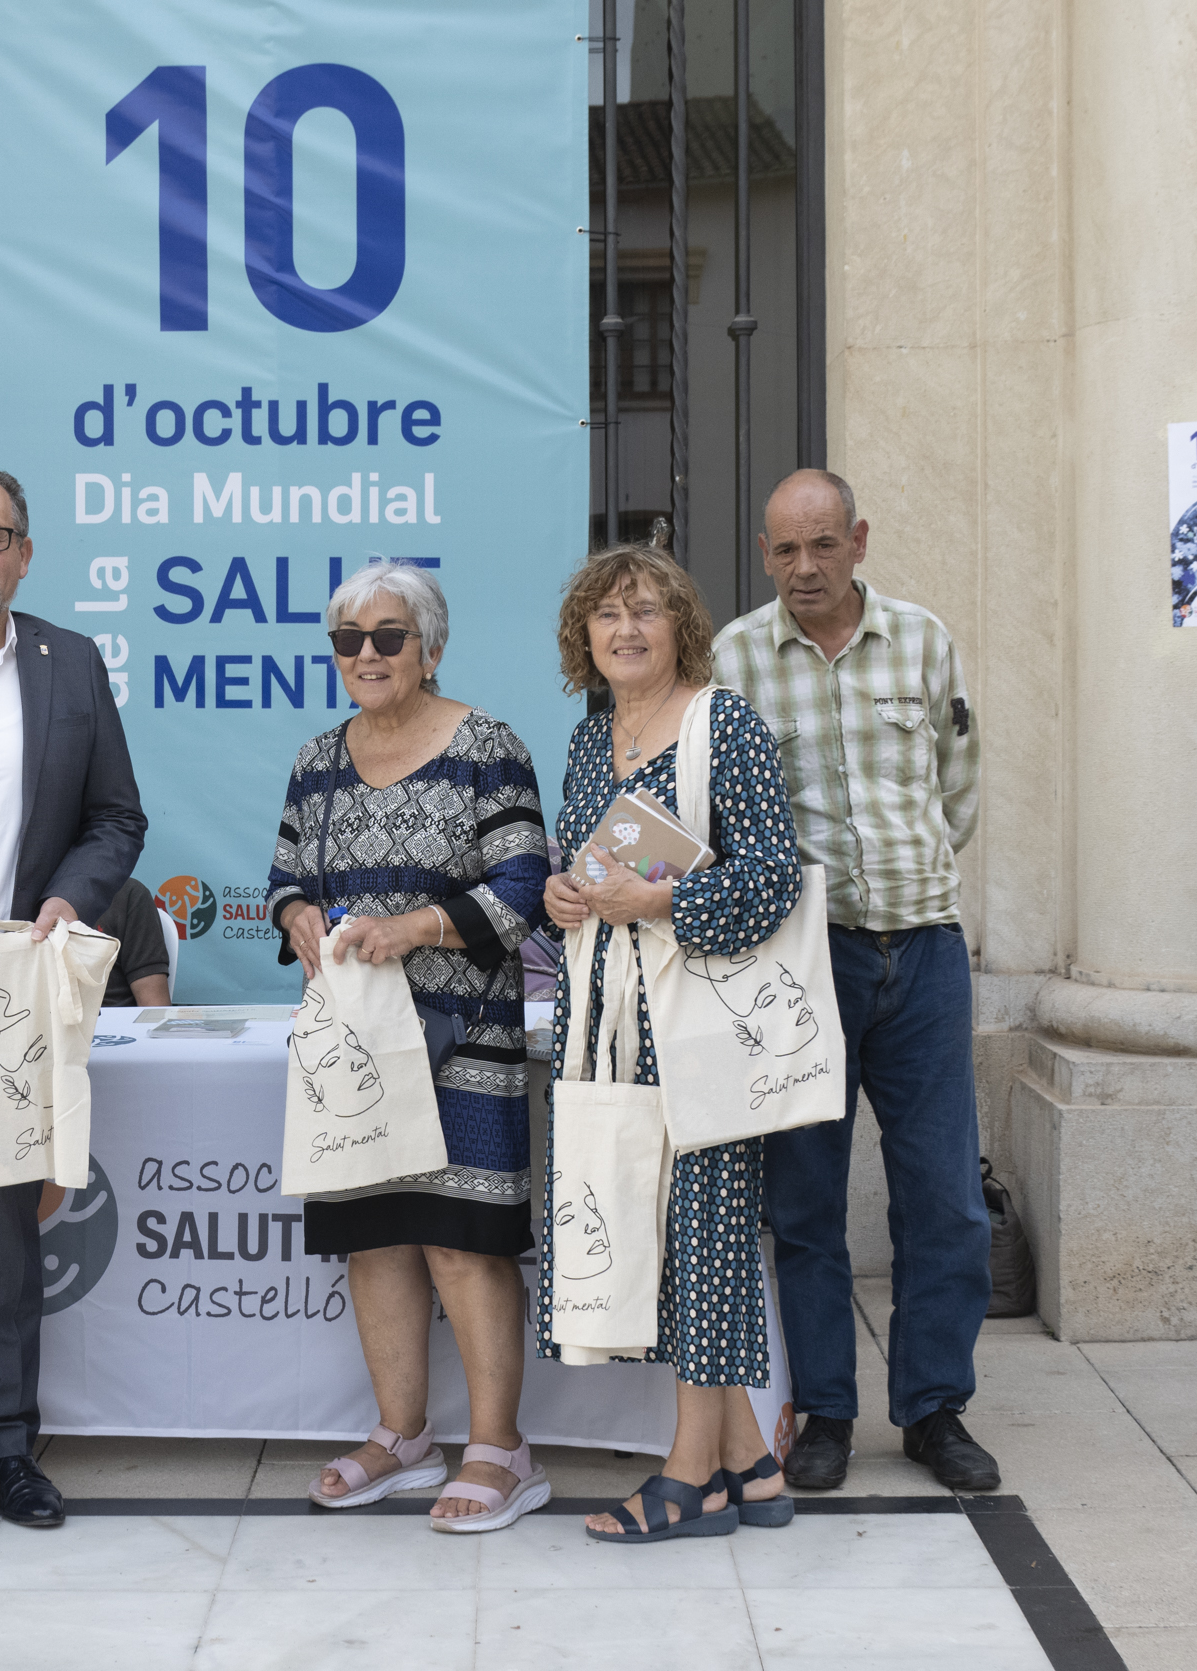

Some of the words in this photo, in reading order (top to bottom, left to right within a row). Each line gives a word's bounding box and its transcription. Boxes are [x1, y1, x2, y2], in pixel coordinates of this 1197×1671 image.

[105, 62, 406, 333] 10
[75, 473, 170, 524] Dia
[193, 472, 442, 524] Mundial
[74, 556, 130, 612] la
[152, 555, 441, 625] SAL
[154, 655, 360, 709] MENT
[874, 697, 894, 705] PONY
[222, 886, 267, 899] assoc
[222, 903, 267, 921] SALU
[750, 1074, 793, 1110] Salut
[792, 1057, 831, 1087] mental
[14, 1125, 54, 1161] Salut
[309, 1131, 351, 1164] Salut
[351, 1122, 390, 1148] mental
[137, 1156, 279, 1195] assoc
[135, 1209, 303, 1263] SALUT
[137, 1273, 347, 1323] Castelló
[571, 1294, 612, 1313] mental
